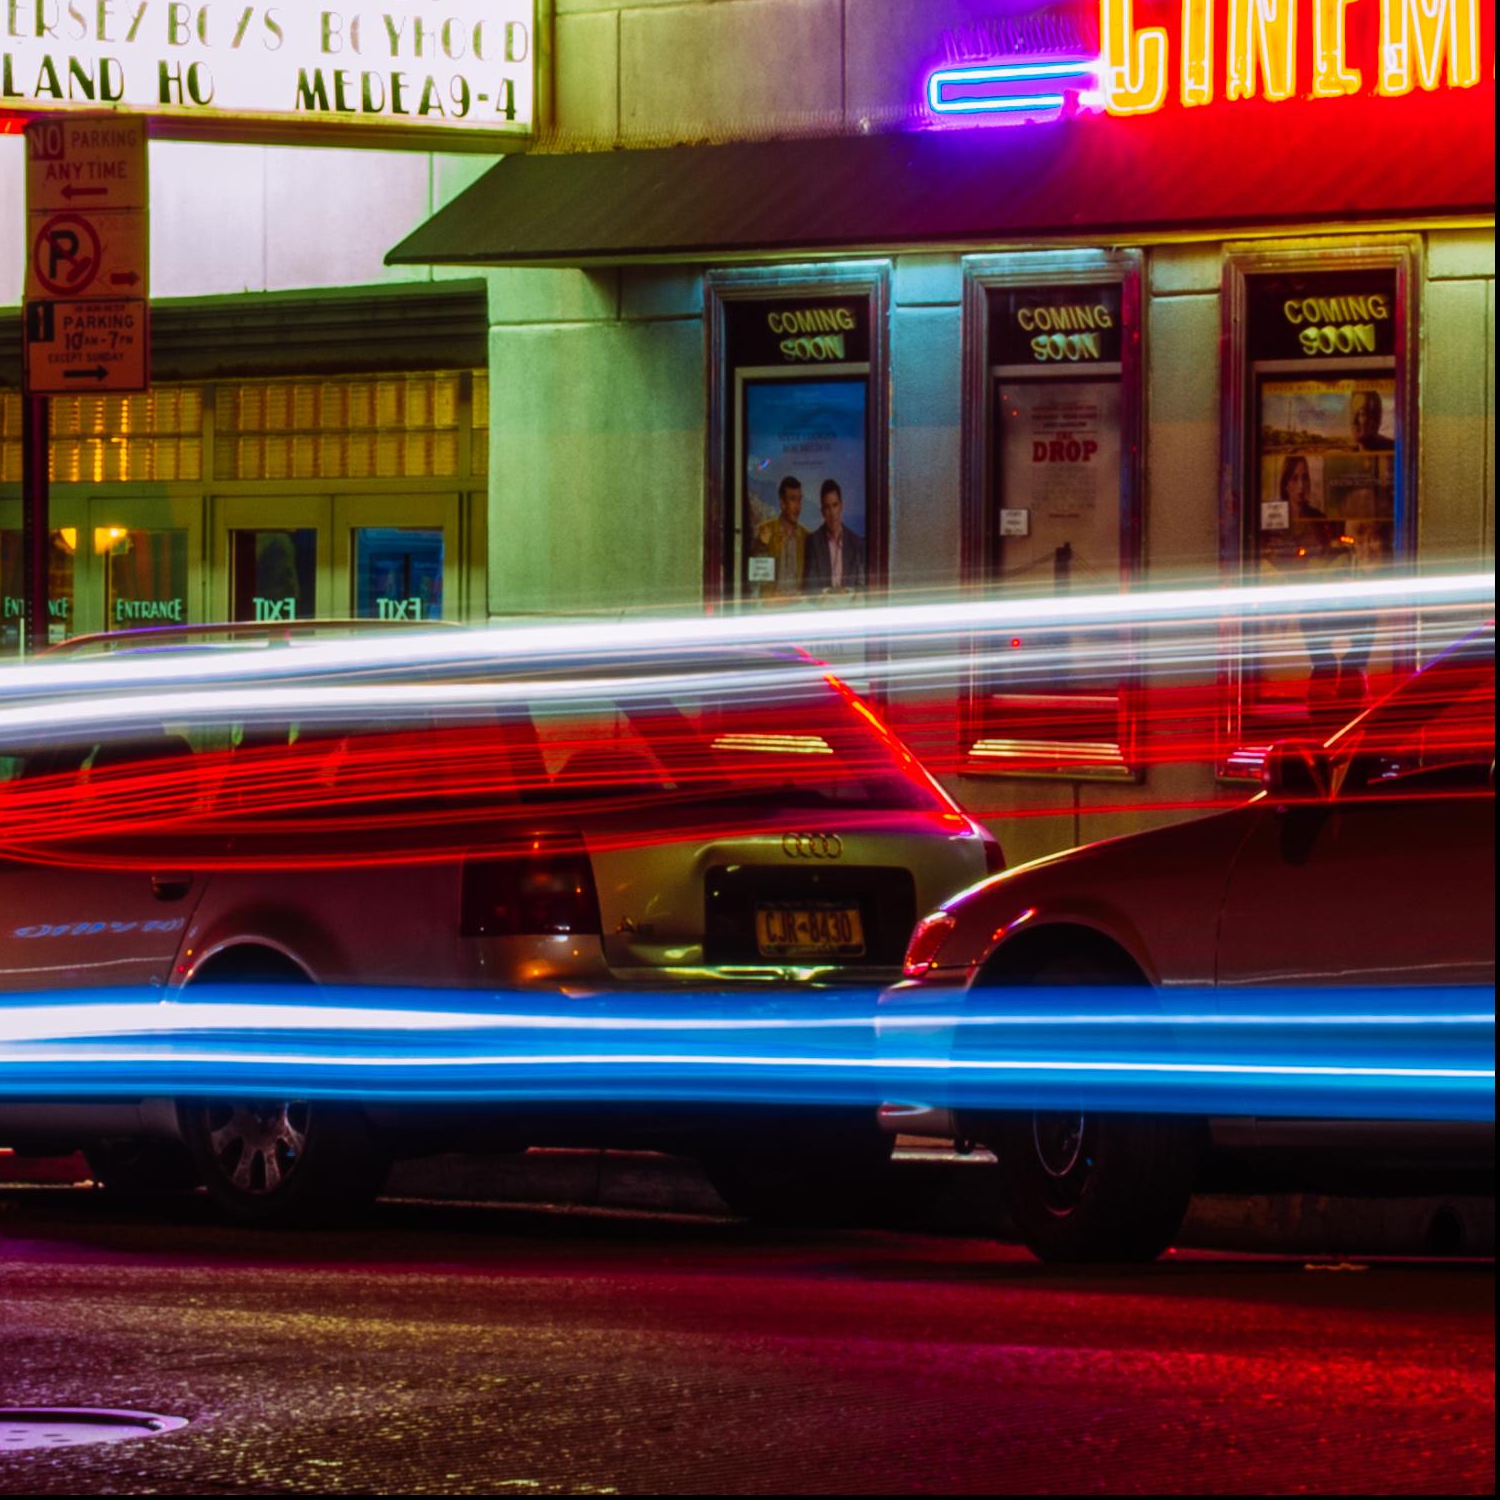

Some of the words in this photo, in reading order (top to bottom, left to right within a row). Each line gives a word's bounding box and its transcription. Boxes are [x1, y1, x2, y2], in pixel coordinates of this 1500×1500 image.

[320, 10, 528, 64] BOYHOOD
[2, 52, 125, 101] LAND
[158, 59, 215, 106] HO
[30, 125, 61, 156] NO
[71, 129, 136, 149] PARKING
[63, 314, 134, 330] PARKING
[768, 308, 855, 334] COMING
[1018, 305, 1113, 331] COMING
[1284, 295, 1389, 324] COMING
[780, 334, 845, 361] SOON
[1031, 332, 1099, 361] SOON
[1299, 324, 1376, 355] SOON
[1033, 440, 1098, 462] DROP
[116, 598, 181, 621] ENTRANCE
